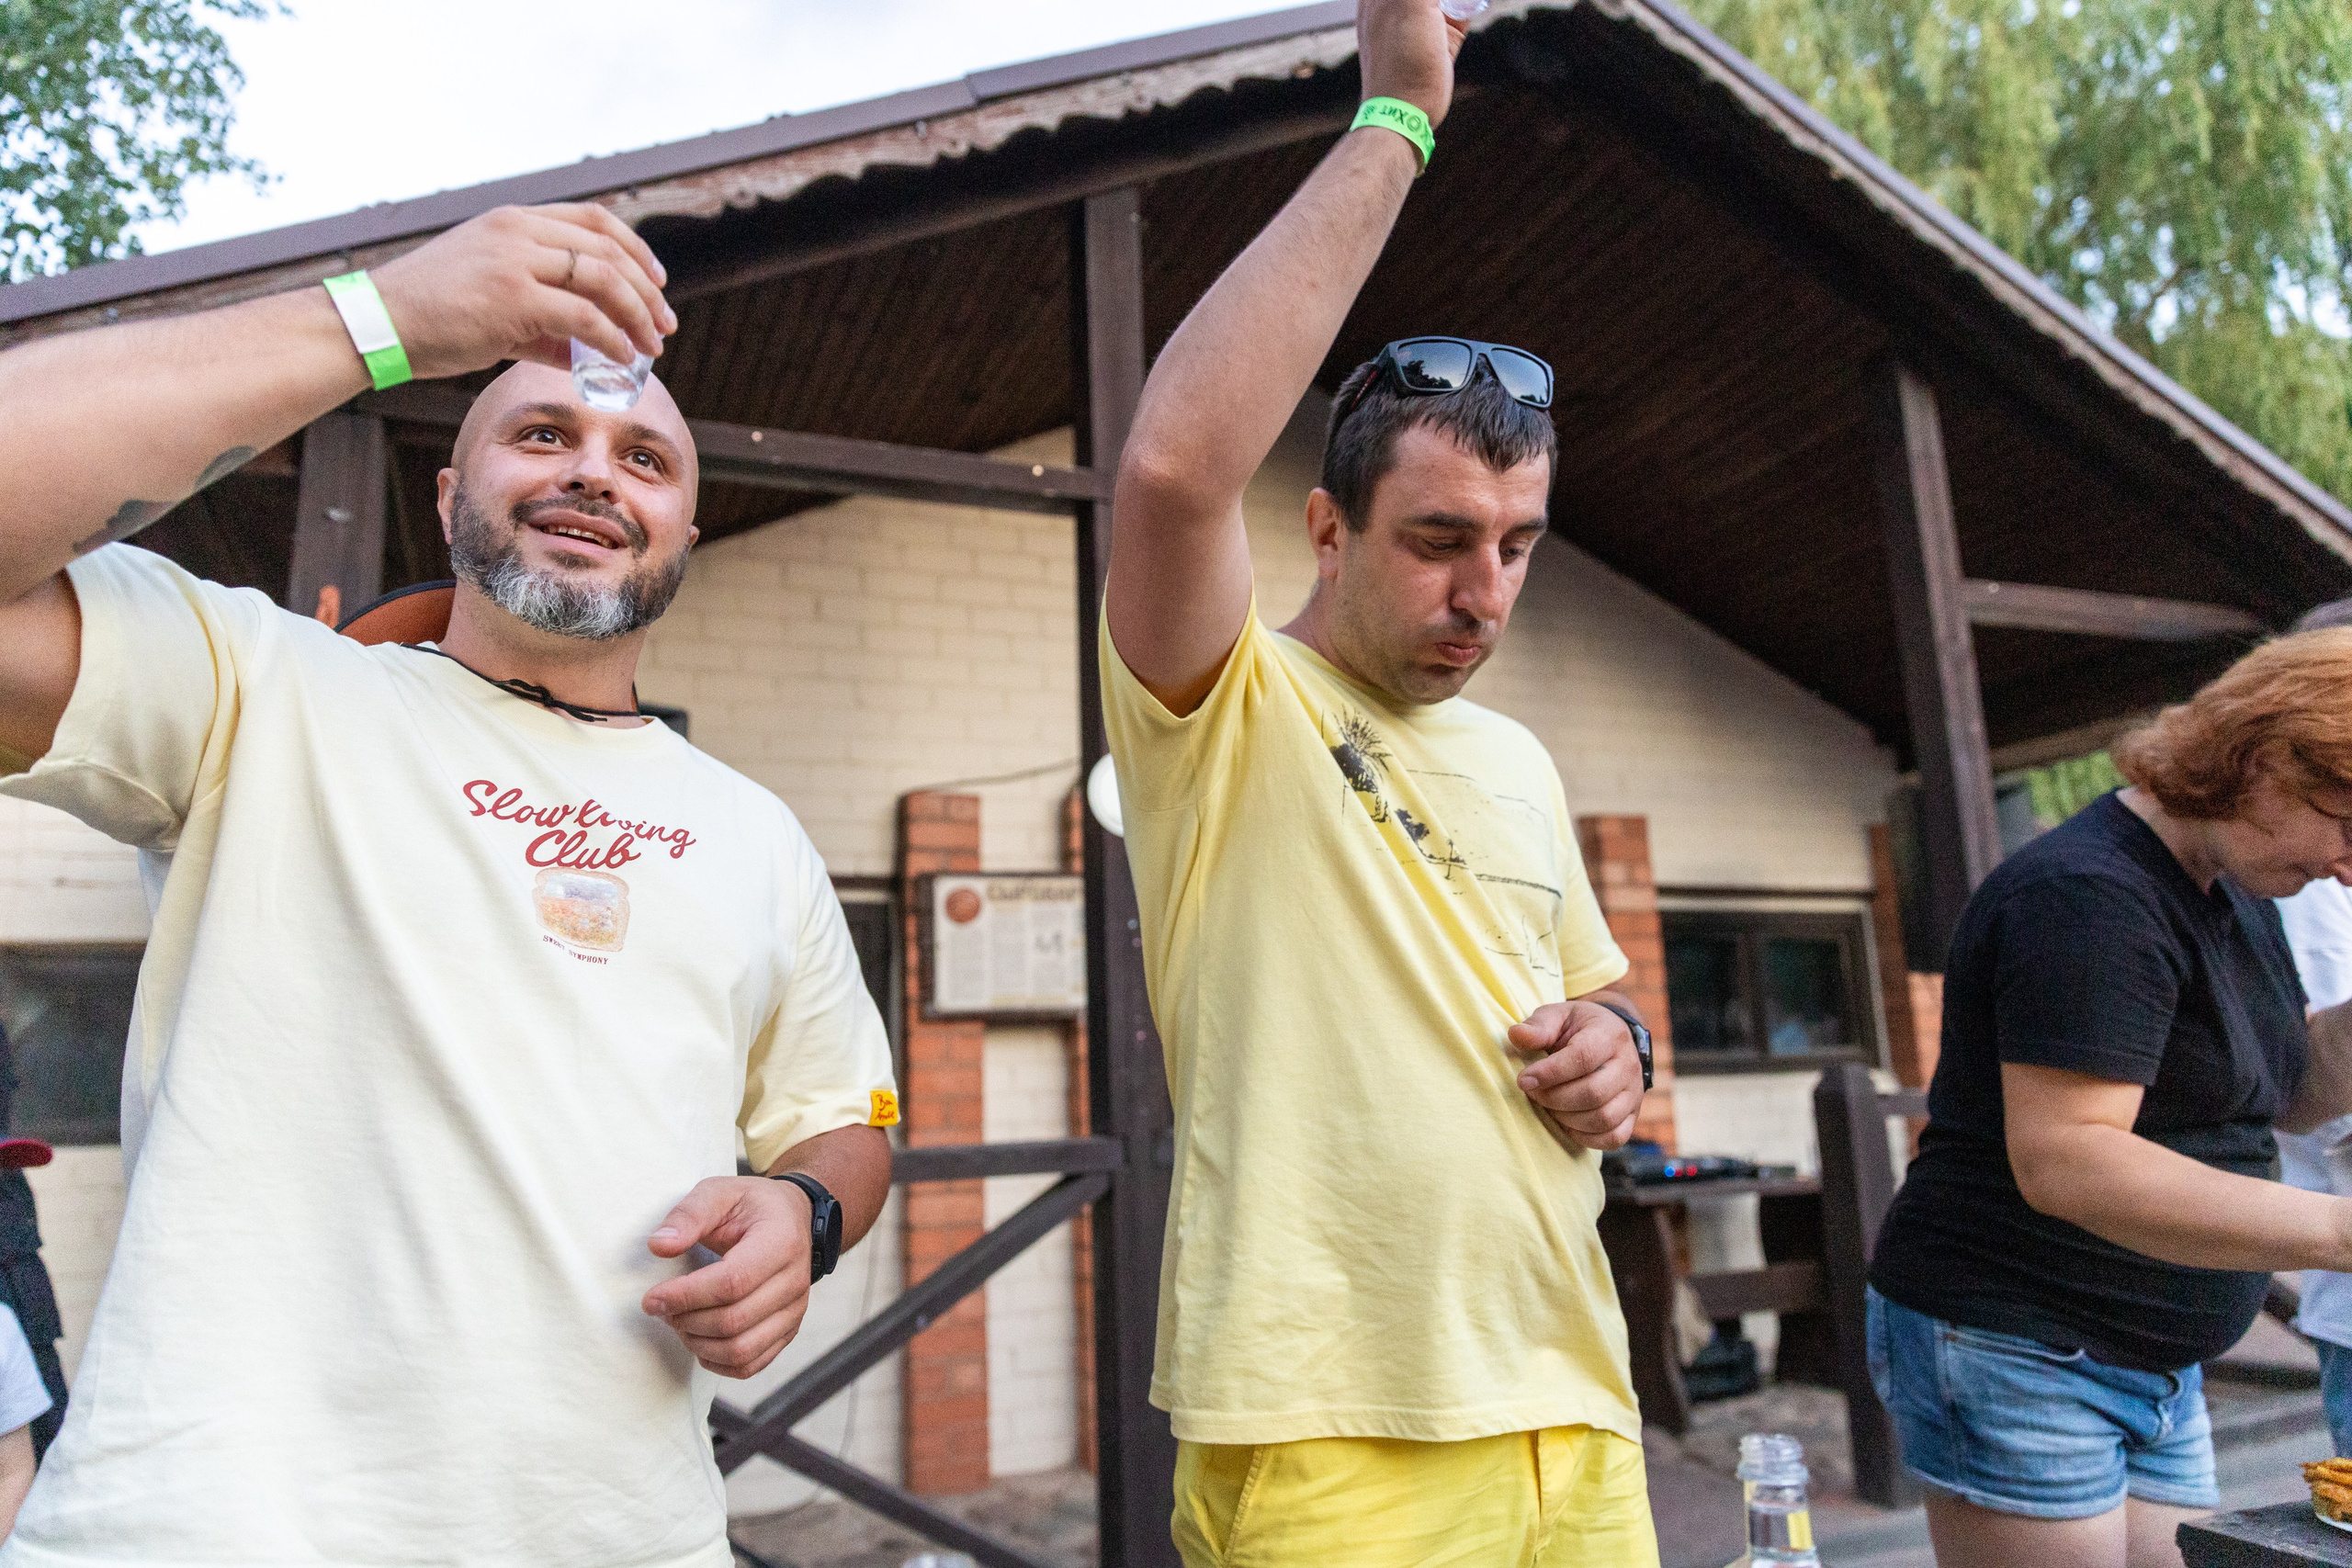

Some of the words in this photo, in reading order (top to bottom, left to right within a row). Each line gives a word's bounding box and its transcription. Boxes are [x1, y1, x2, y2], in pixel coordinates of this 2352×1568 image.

[462, 779, 577, 828] Slow
[525, 829, 642, 869] Club
[568, 949, 609, 965] SYMPHONY
